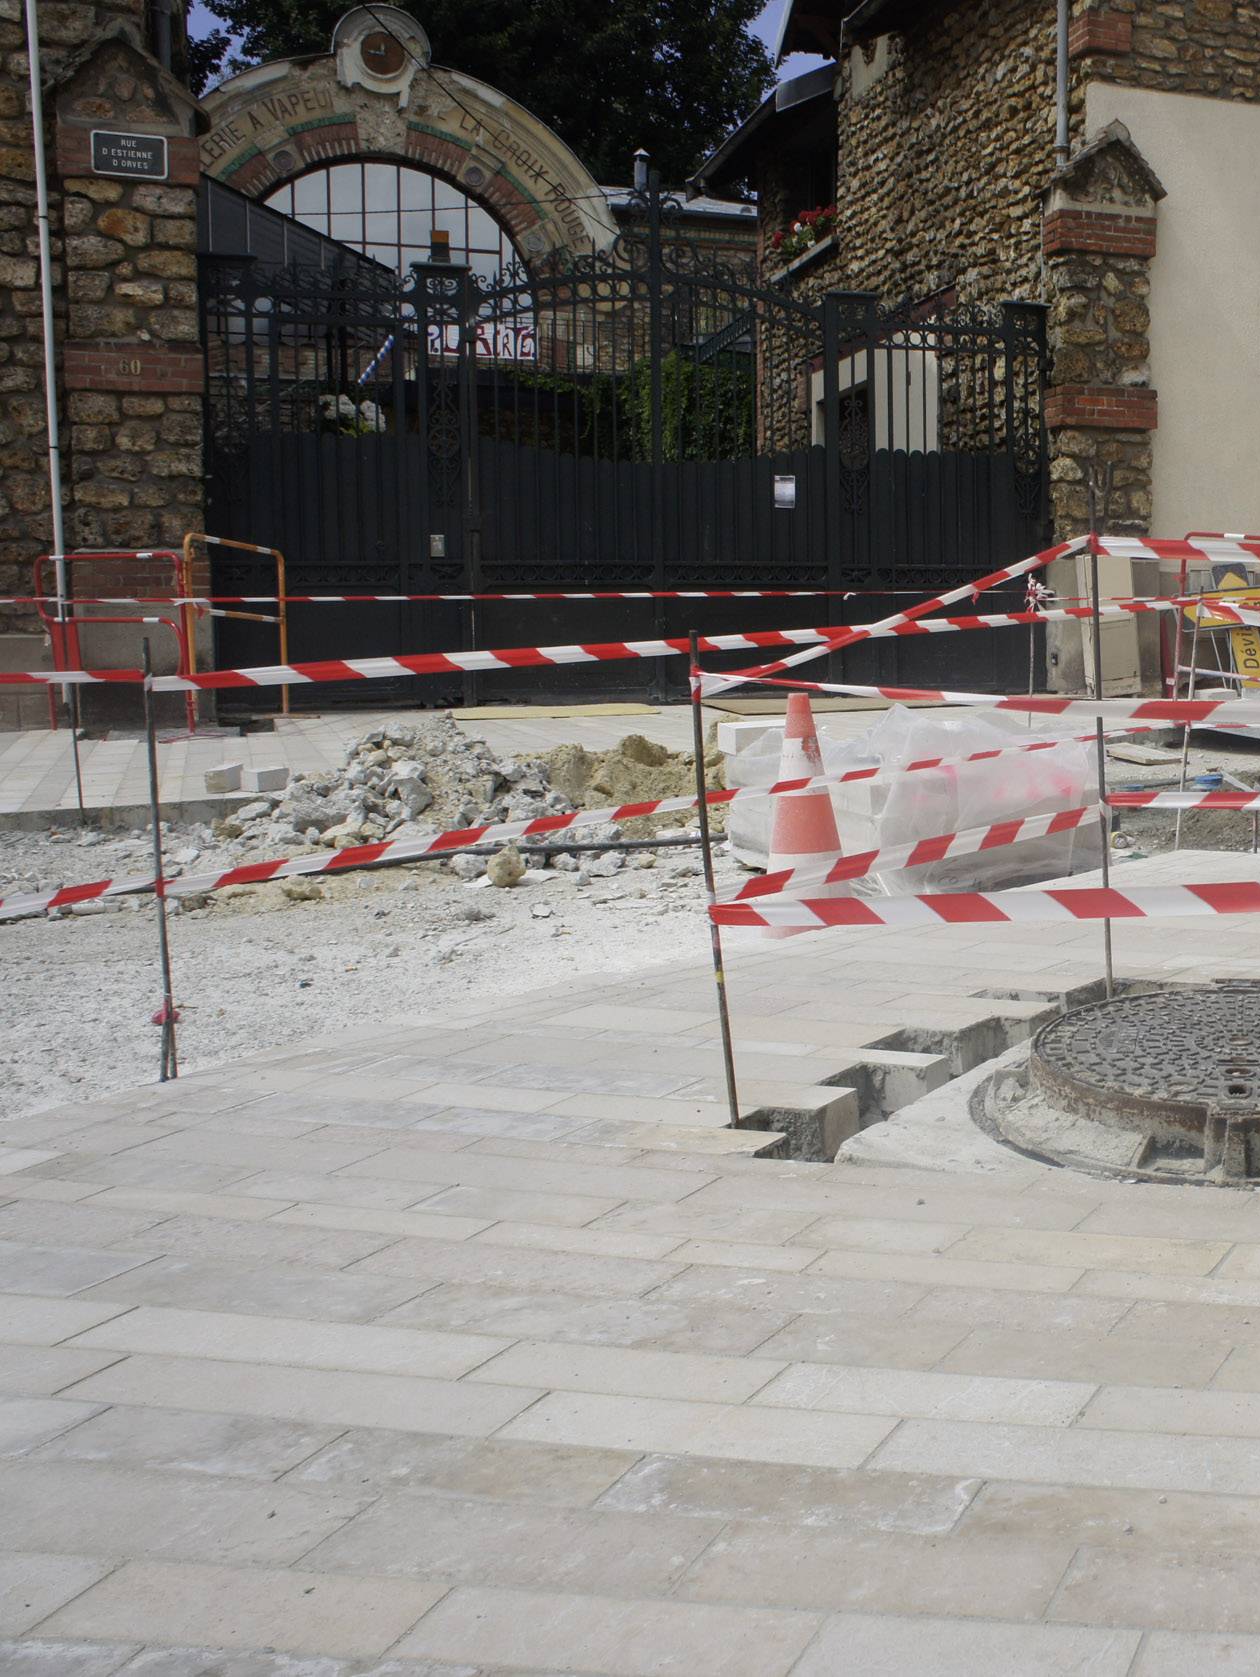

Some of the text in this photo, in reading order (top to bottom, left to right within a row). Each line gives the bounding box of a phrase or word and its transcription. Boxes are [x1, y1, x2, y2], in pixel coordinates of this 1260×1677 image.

[120, 139, 137, 148] RUE
[492, 129, 549, 185] CROIX
[543, 181, 592, 249] ROUGE
